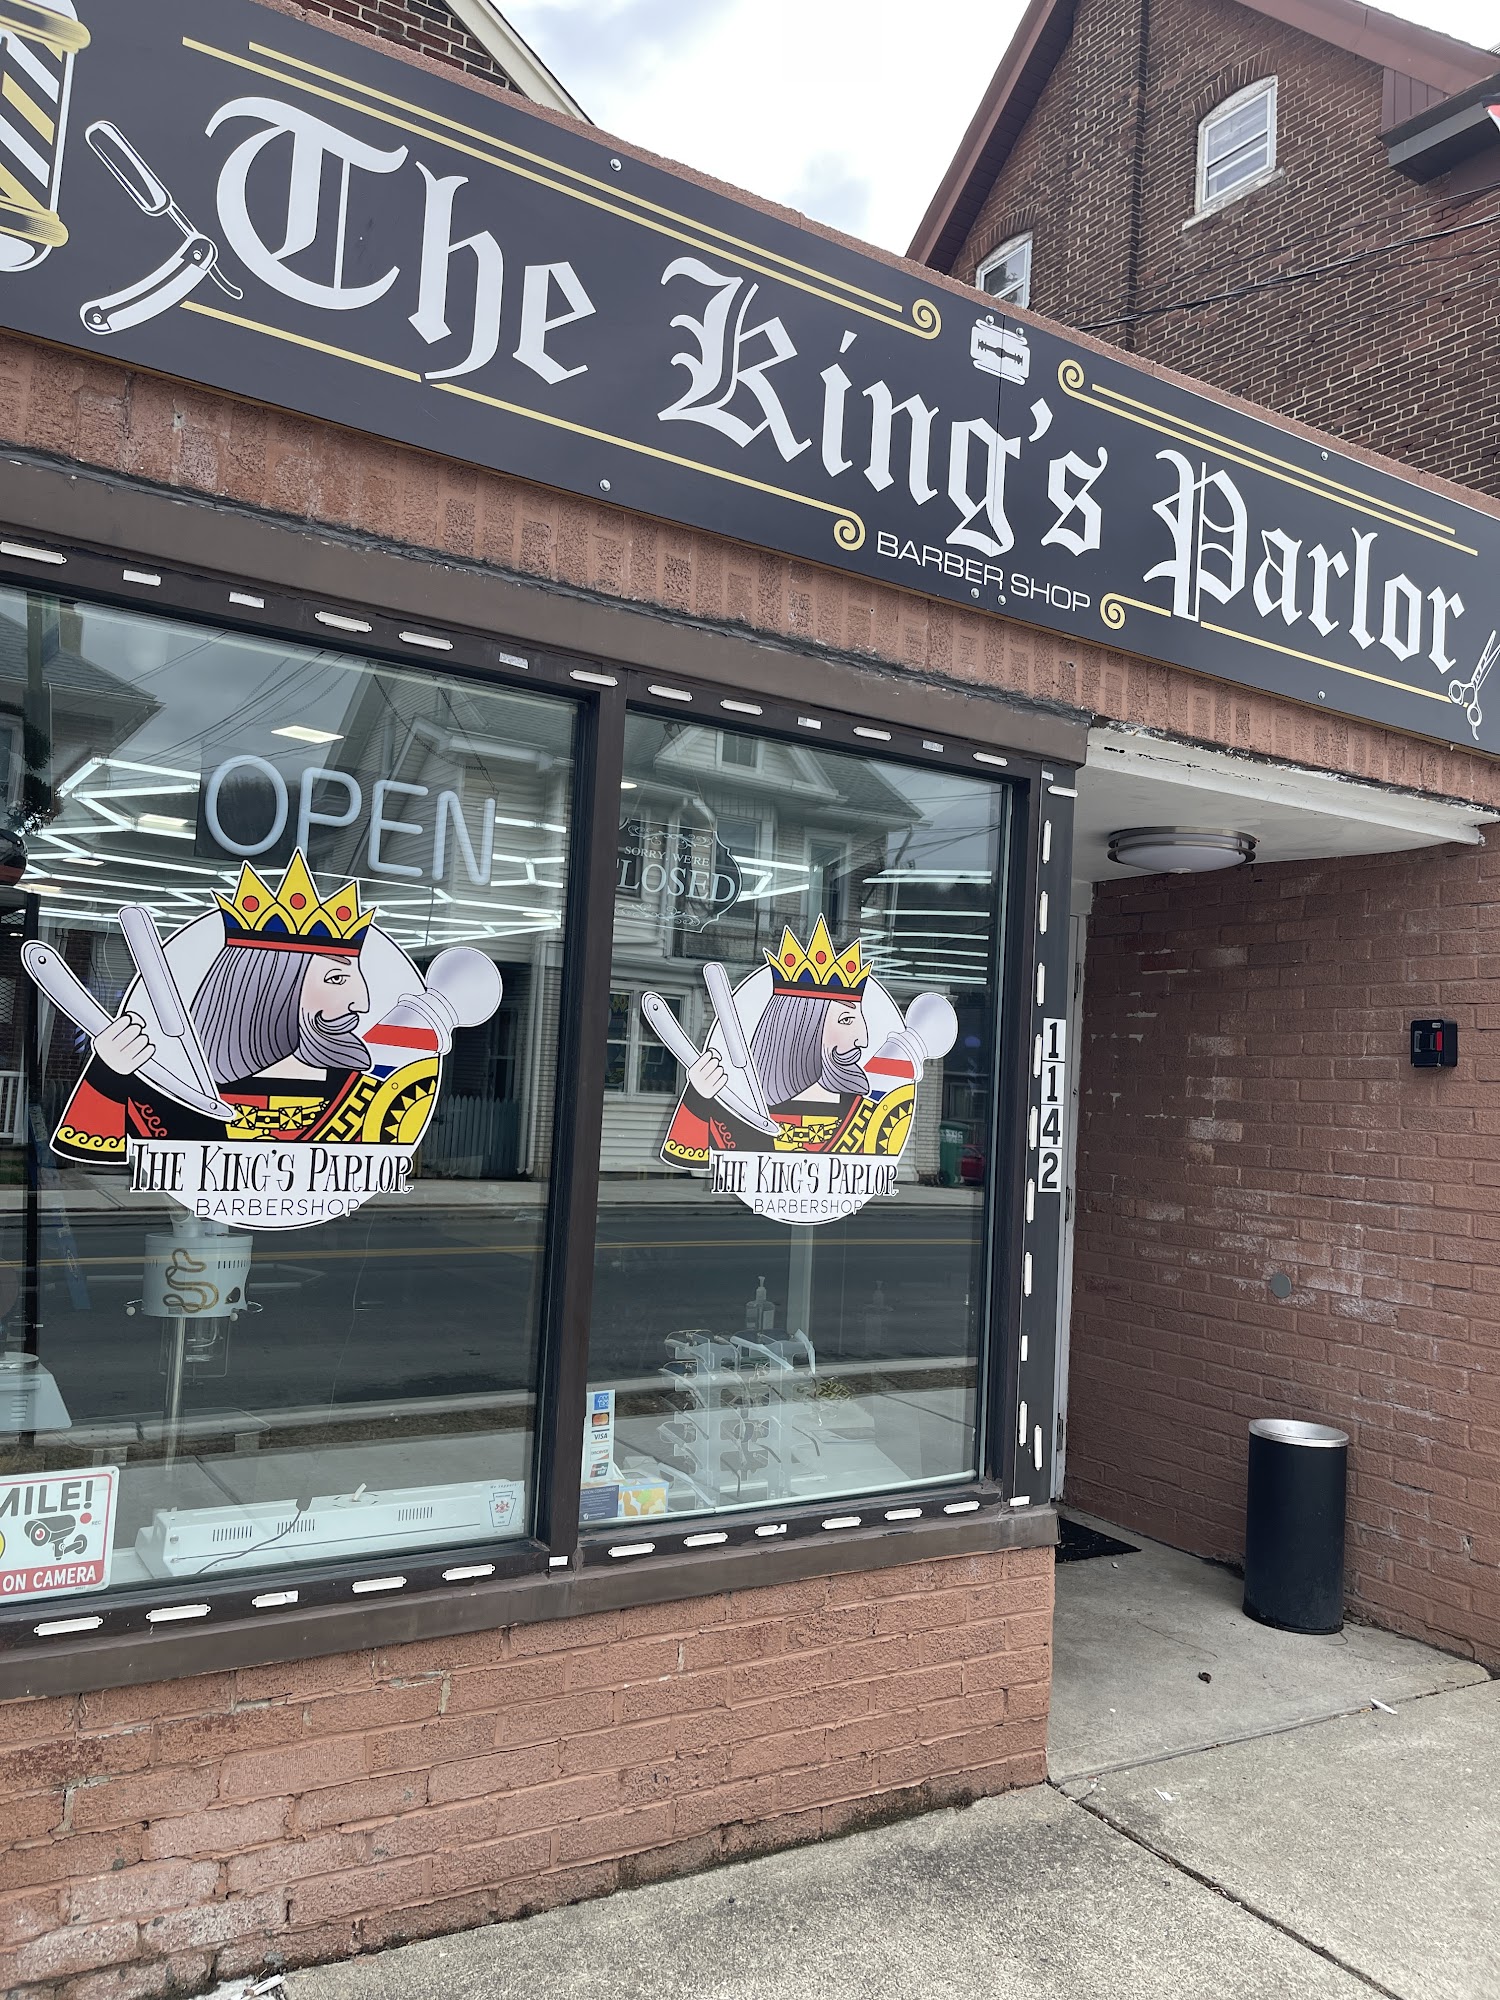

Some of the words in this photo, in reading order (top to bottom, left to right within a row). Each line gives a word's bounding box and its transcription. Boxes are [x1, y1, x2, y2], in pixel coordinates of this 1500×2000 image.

[205, 96, 597, 384] The
[657, 256, 1108, 558] King's
[1143, 449, 1465, 675] Parlor
[876, 530, 1004, 591] BARBER
[1009, 573, 1091, 612] SHOP
[204, 754, 497, 886] OPEN
[616, 858, 736, 903] LOSED
[672, 853, 710, 867] WE'RE
[131, 1143, 186, 1192] THE
[197, 1145, 295, 1192] KING'S
[306, 1147, 414, 1193] PARLOR
[712, 1154, 748, 1193] THE
[755, 1155, 820, 1194] KING'S
[827, 1157, 899, 1196] PARLOR
[195, 1198, 361, 1217] BARBERSHOP
[753, 1198, 863, 1215] BARBERSHOP
[593, 1432, 608, 1440] VISA
[2, 1573, 27, 1593] ON
[33, 1564, 97, 1588] CAMERA
